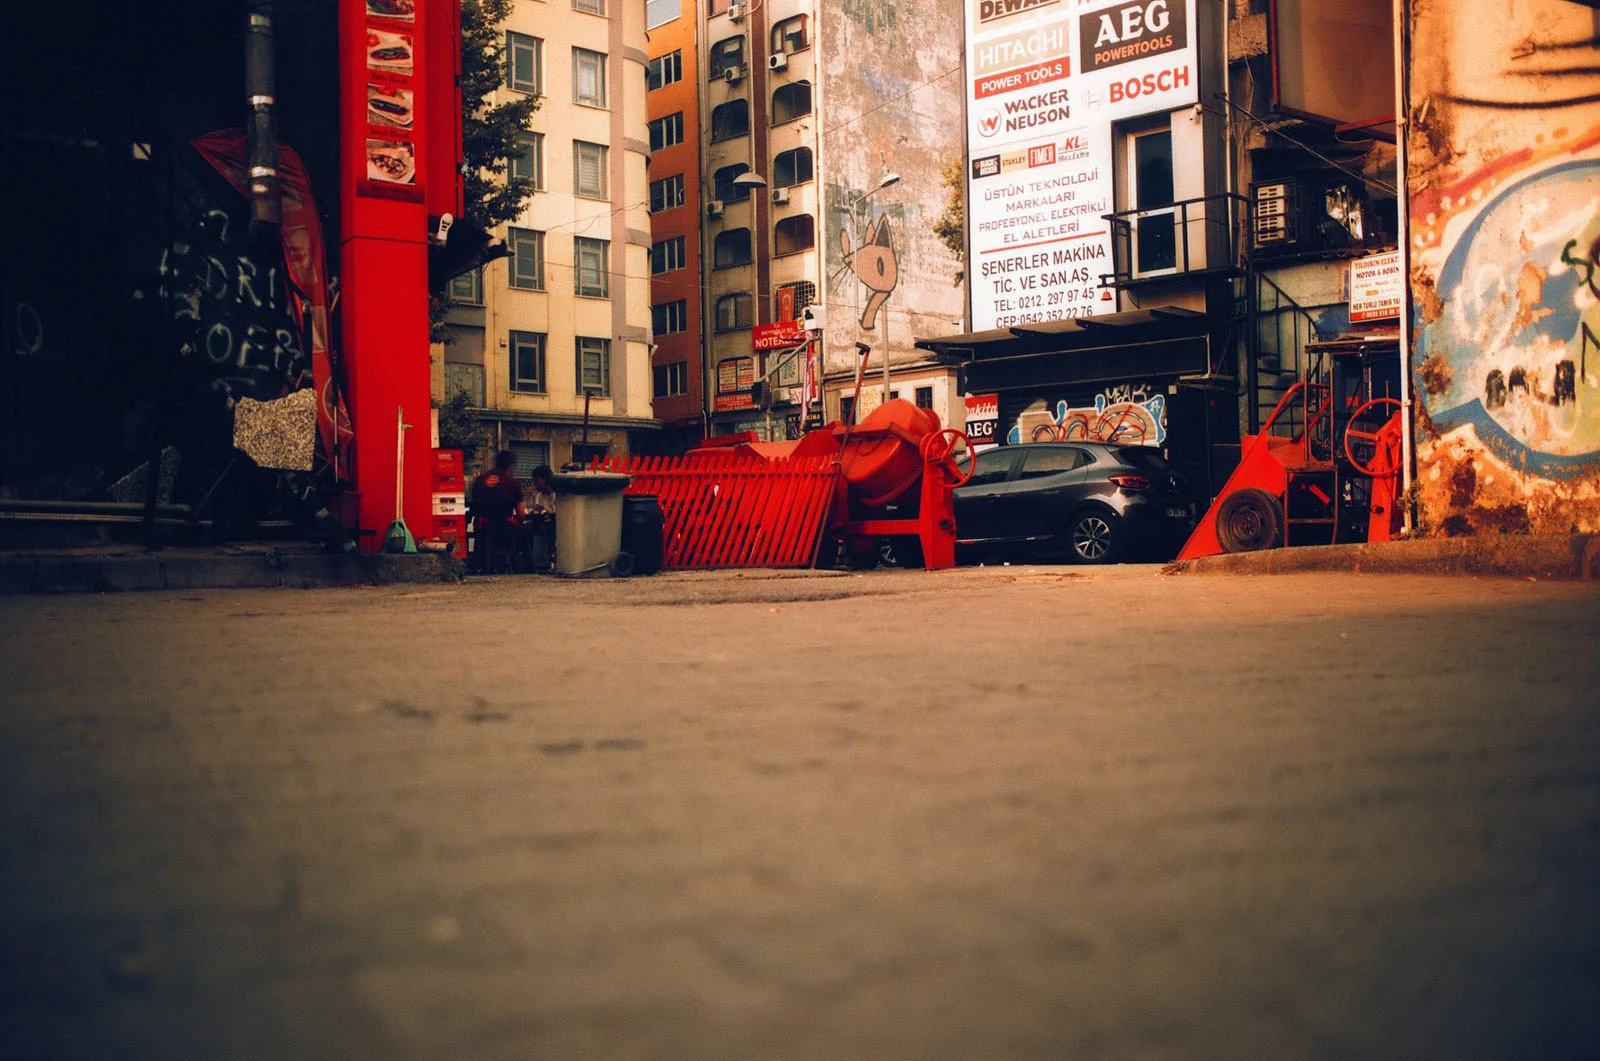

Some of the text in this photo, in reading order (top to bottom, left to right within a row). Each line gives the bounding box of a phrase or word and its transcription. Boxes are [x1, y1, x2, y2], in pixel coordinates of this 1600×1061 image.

[1094, 0, 1170, 48] AEG
[979, 27, 1063, 69] HITACHI
[1094, 34, 1173, 65] POWERTOOLS
[981, 63, 1063, 94] POWER TOOLS
[1109, 65, 1189, 104] BOSCH
[1004, 89, 1070, 115] WACKER
[1006, 105, 1070, 132] NEUSON
[984, 167, 1098, 201] ÜSTÜN TEKNOLOJİ
[979, 198, 1106, 232] PROFESYONEL ELEKTRİKLİ
[1006, 191, 1075, 212] MARKALARI
[1003, 219, 1079, 244] EL ALETLERİ
[981, 243, 1106, 279] ŞENERLER MAKİNA
[993, 267, 1093, 294] TİC. VE SAN.AŞ.
[993, 299, 1016, 312] TEL:
[1047, 291, 1064, 306] 297
[1067, 289, 1079, 302] 97
[1082, 287, 1095, 300] 45
[1046, 309, 1063, 322] 352
[1066, 307, 1078, 320] 22
[1081, 305, 1093, 317] 76
[966, 422, 993, 438] AEG
